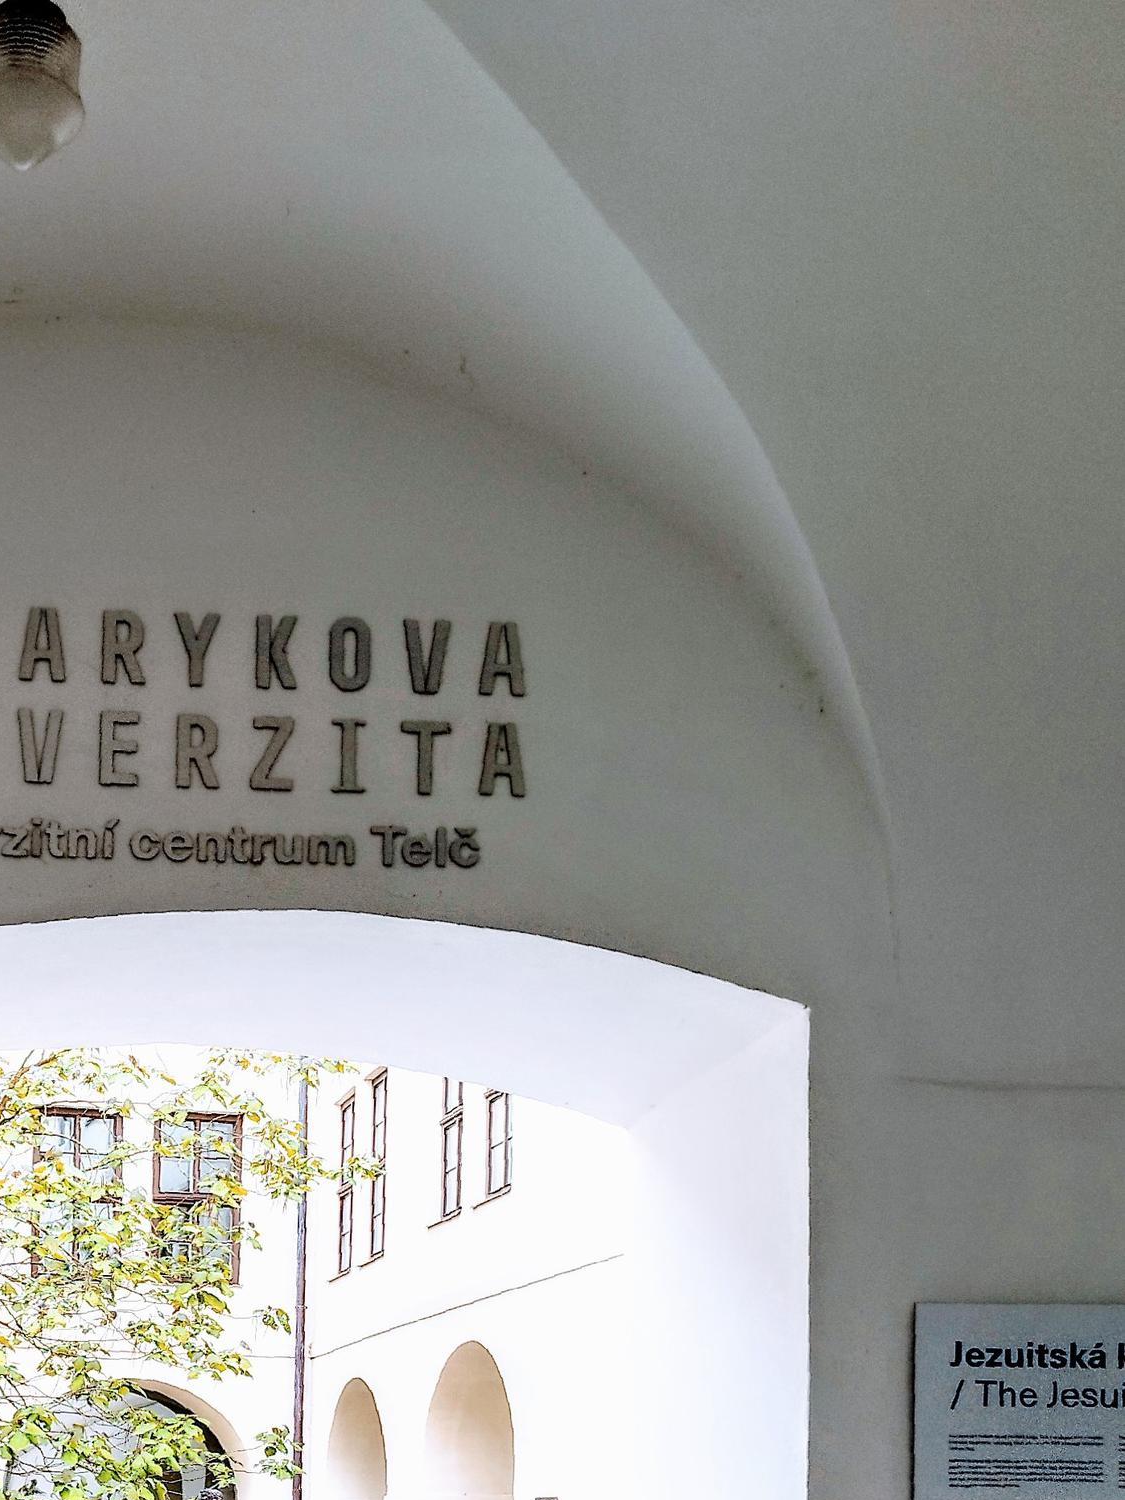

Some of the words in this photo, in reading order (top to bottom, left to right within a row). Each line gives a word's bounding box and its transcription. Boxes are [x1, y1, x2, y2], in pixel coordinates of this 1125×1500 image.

[129, 824, 358, 866] centrum
[370, 824, 483, 870] Telč
[949, 1340, 1106, 1369] Jezuitská
[975, 1379, 1037, 1408] The
